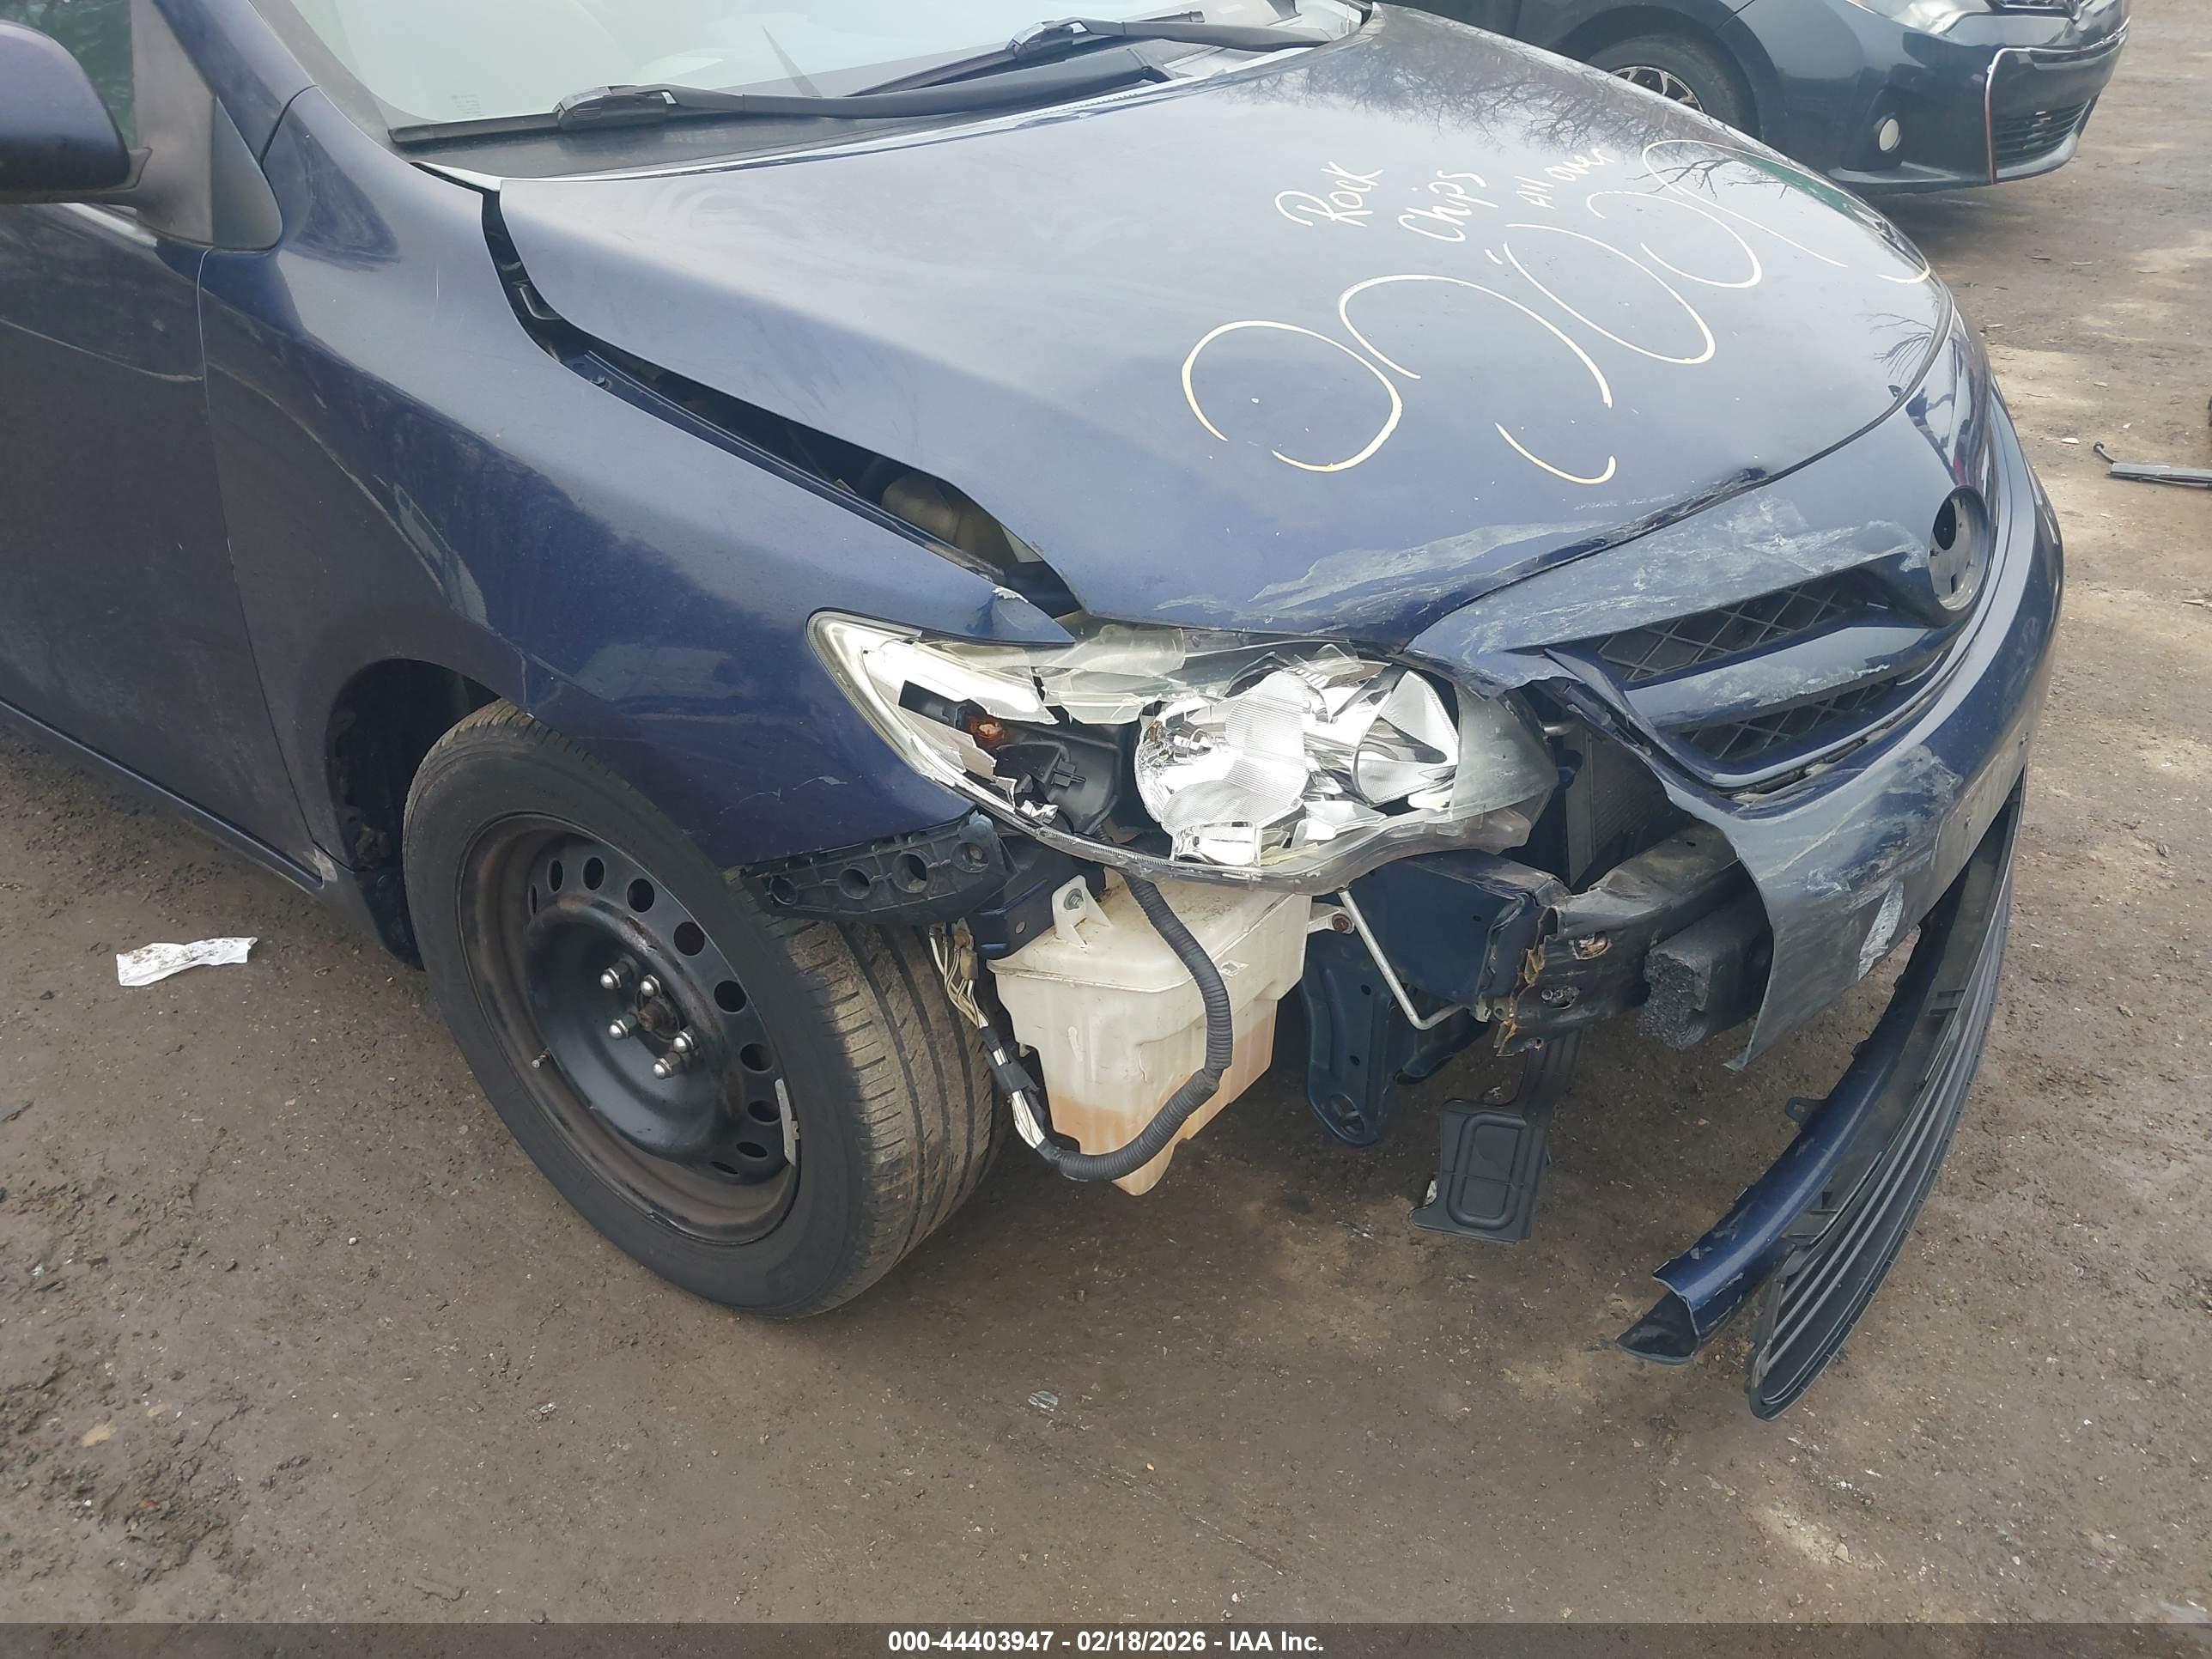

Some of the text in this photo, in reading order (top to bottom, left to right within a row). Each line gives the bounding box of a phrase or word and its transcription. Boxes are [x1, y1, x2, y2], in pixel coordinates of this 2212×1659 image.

[1274, 161, 1384, 227] Rock
[1545, 148, 1615, 182] over
[1397, 169, 1499, 243] Chips
